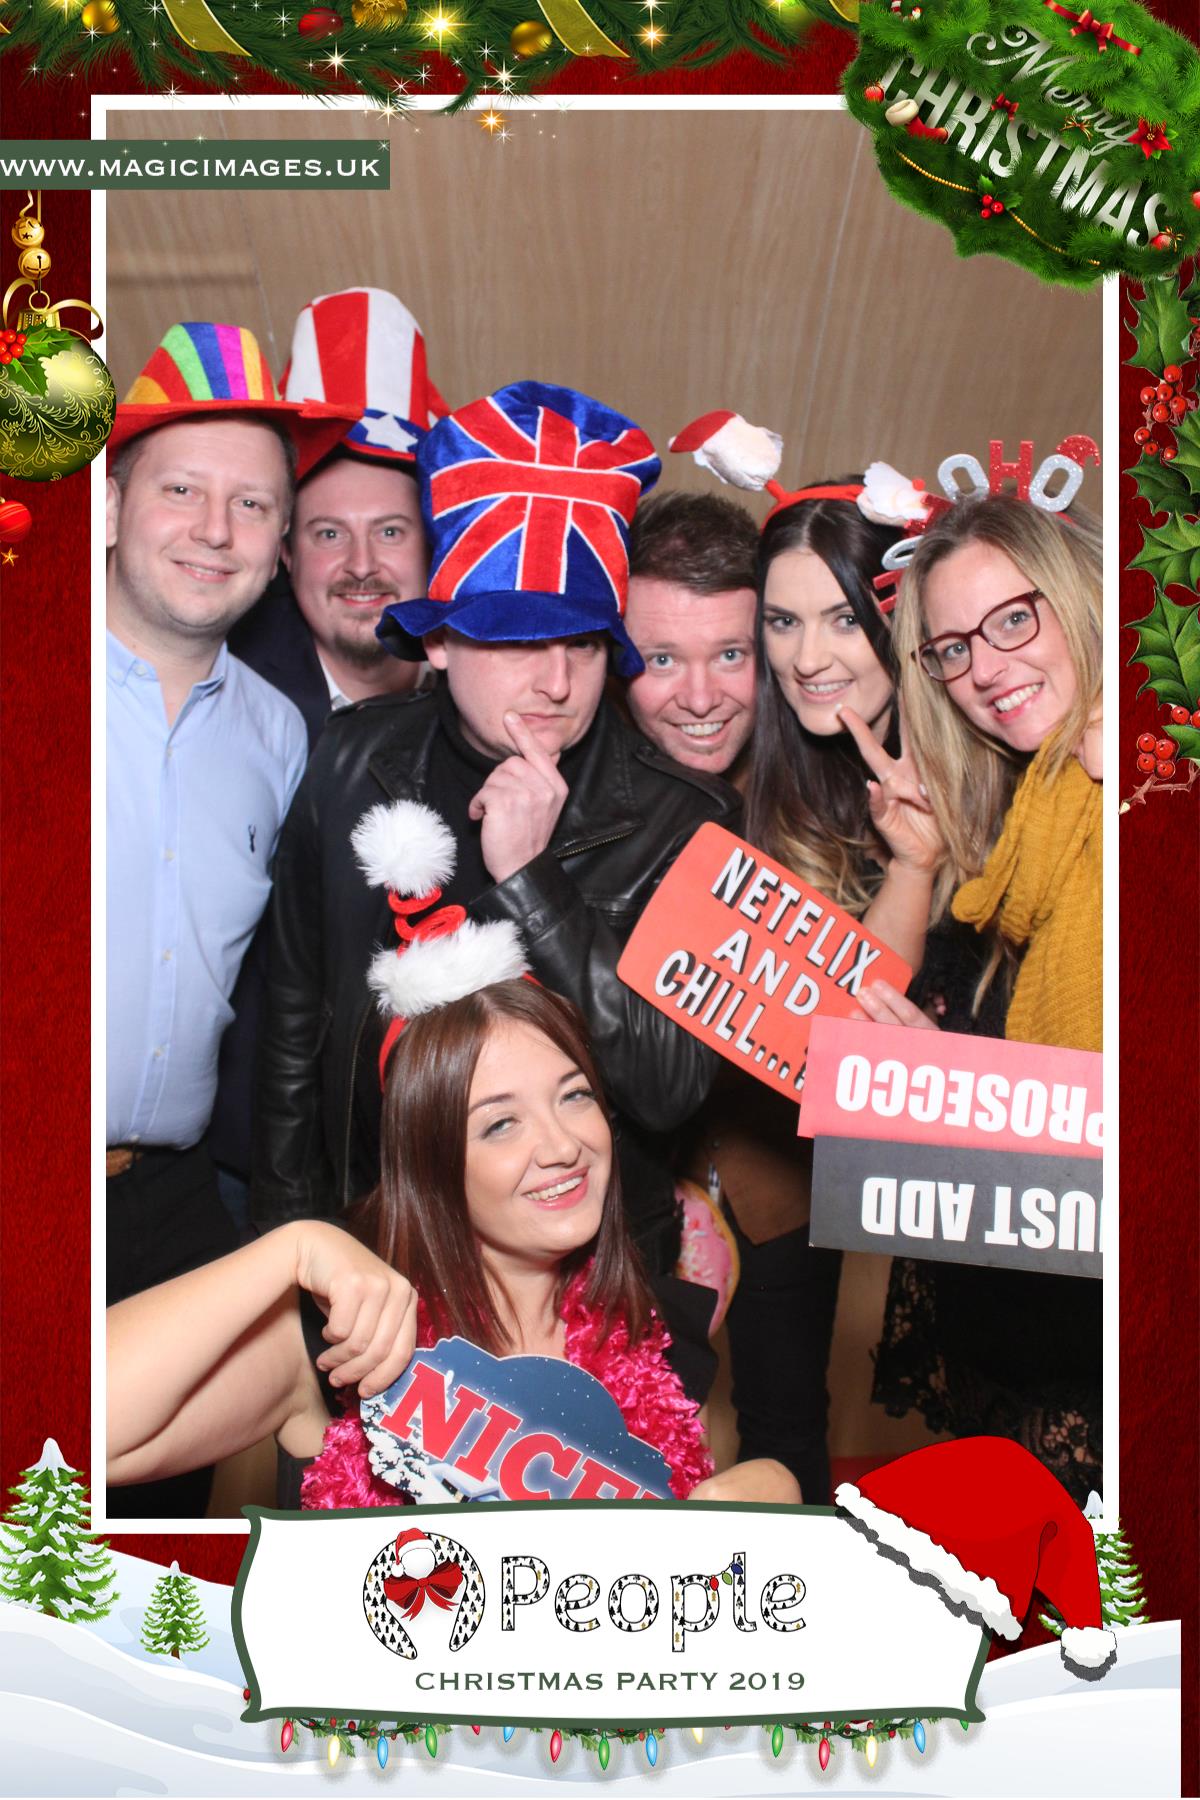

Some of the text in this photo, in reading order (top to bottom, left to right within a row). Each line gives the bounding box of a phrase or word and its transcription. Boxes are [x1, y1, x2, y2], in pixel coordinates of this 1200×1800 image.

[710, 846, 882, 998] NETFLIX
[711, 928, 821, 1016] AND
[861, 1177, 1103, 1254] UST ADD
